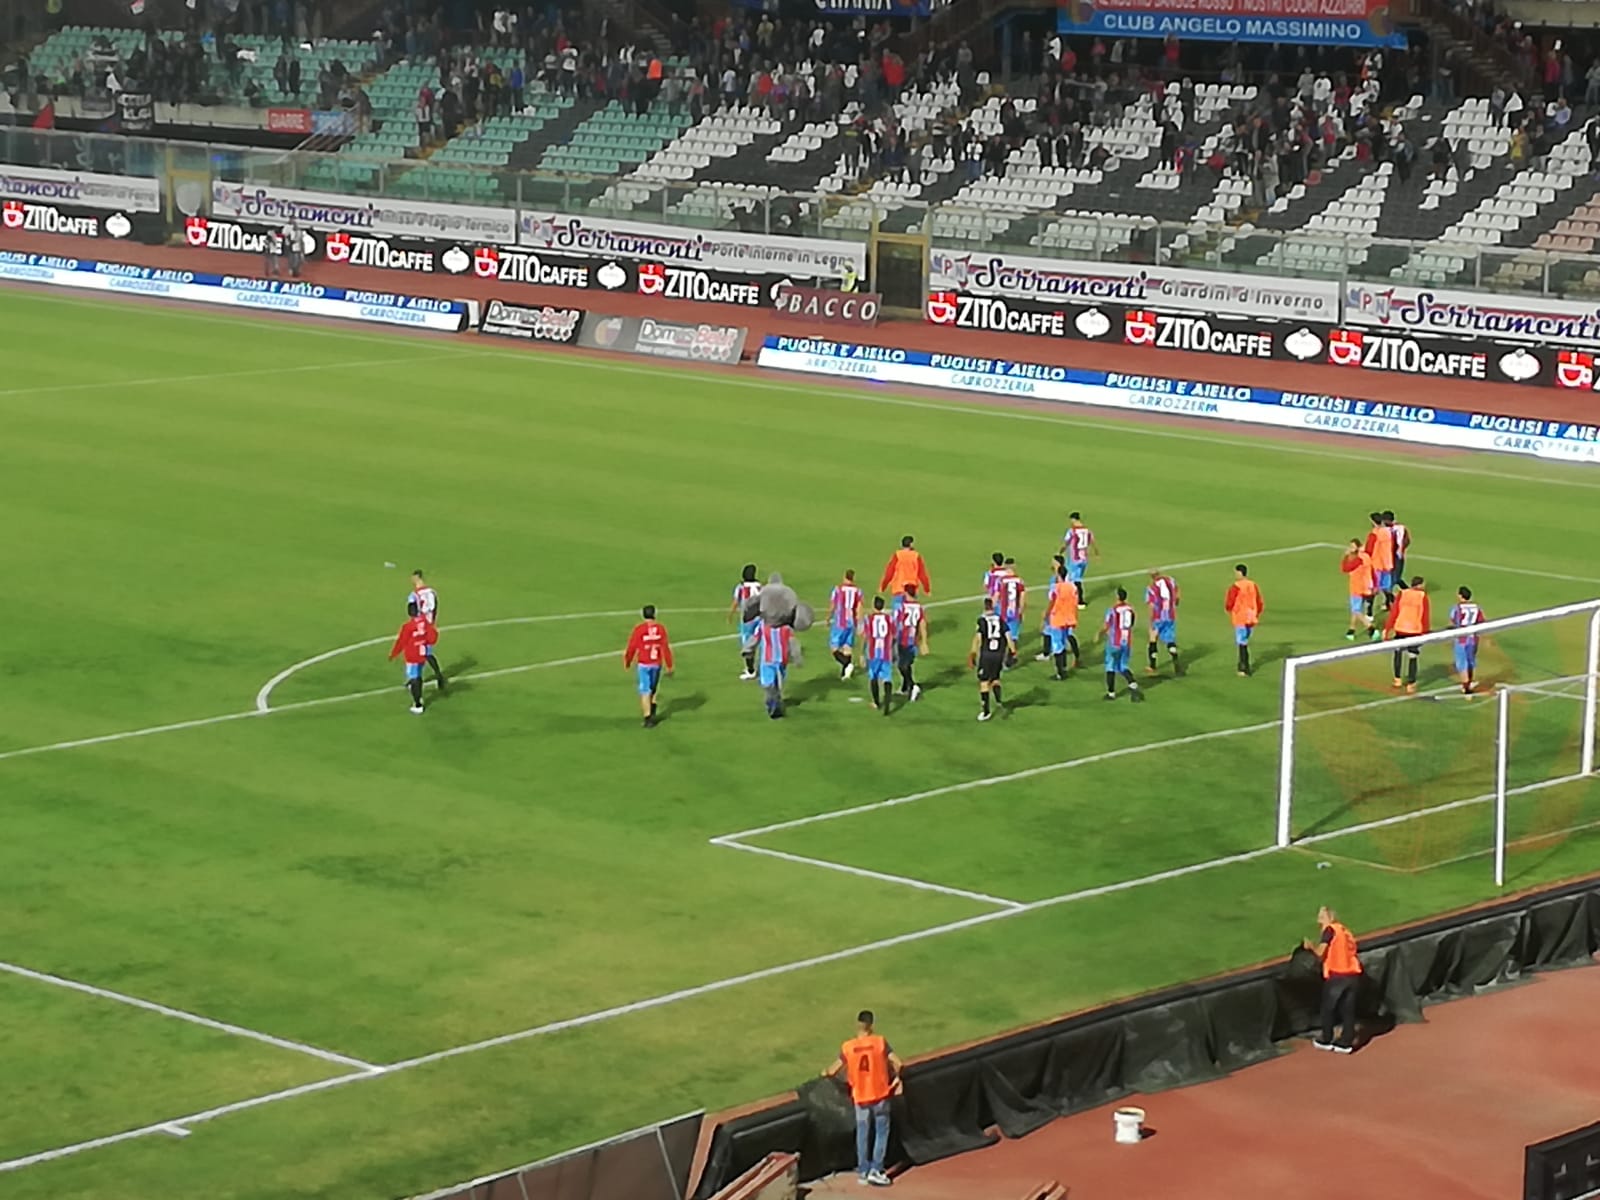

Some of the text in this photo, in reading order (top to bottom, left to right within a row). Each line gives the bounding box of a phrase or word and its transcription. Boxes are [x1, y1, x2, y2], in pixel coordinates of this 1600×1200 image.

[1103, 14, 1361, 39] CLUB ANGELO MASSIMINO
[246, 189, 374, 228] Serramenti
[558, 219, 703, 262] Serramenti
[712, 243, 744, 258] Porte
[29, 254, 35, 265] E
[95, 262, 194, 283] PUGLISI E AIELLO
[975, 258, 1147, 300] Serramenti
[1161, 281, 1231, 302] Giardini
[270, 281, 278, 293] E
[345, 290, 451, 313] PUGLISI E AIELLO
[788, 294, 876, 320] BACCO
[360, 306, 426, 323] CARROZZERIA
[840, 345, 850, 357] E
[852, 345, 906, 362] AIELLO
[930, 354, 1066, 381] PUGLISI E AIELLO
[951, 373, 1035, 393] CARROZZERIA
[1106, 372, 1251, 401] PUGLISI E AIELLO
[1280, 392, 1435, 423] PUGLISI E AIELLO
[1304, 412, 1400, 435] CARROZZERIA
[1469, 413, 1544, 435] PUGLISI
[1547, 422, 1559, 437] E
[1007, 583, 1017, 601] 5
[1460, 608, 1479, 627] 27
[858, 1054, 870, 1073] A
